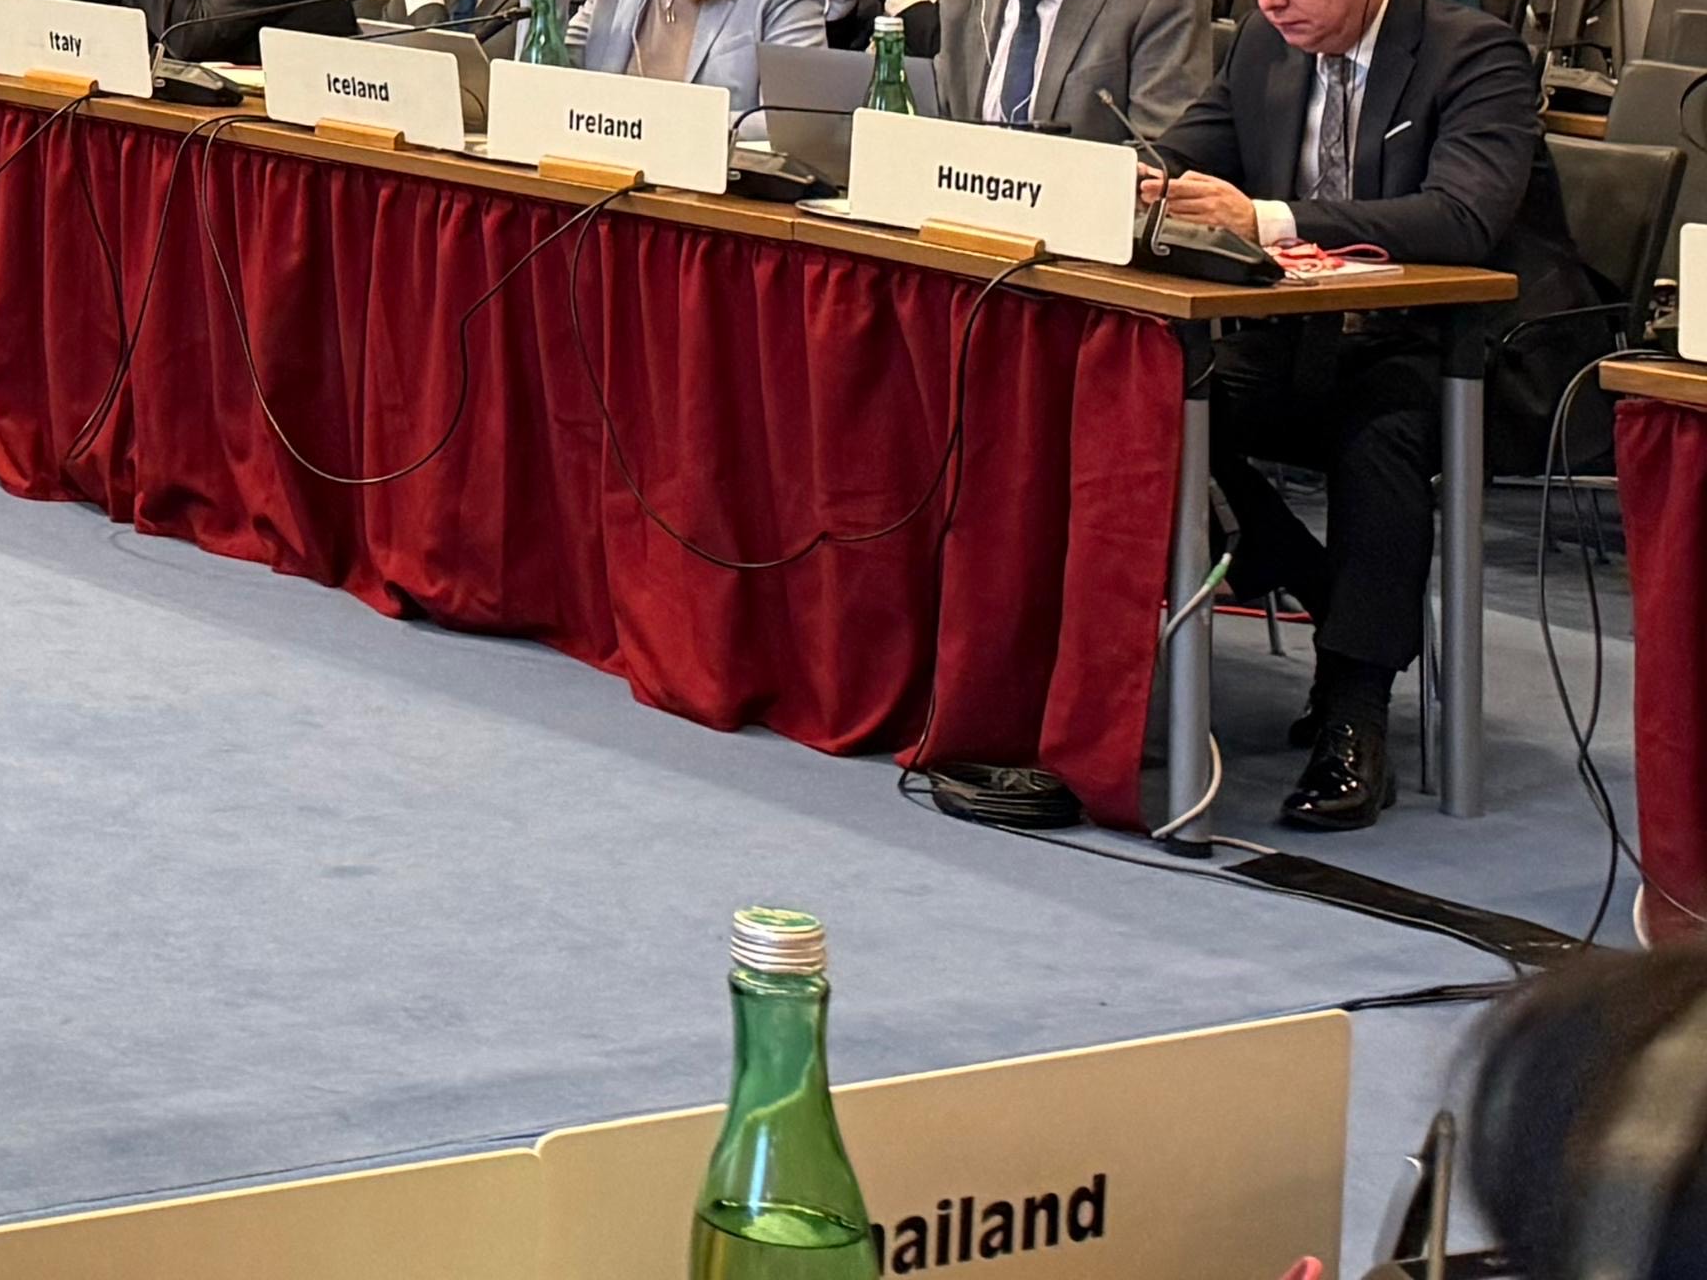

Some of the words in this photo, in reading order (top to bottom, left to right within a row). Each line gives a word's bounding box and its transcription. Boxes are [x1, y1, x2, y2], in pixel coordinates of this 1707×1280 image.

[49, 31, 82, 57] Italy
[326, 73, 390, 102] Iceland
[569, 109, 642, 140] Ireland
[937, 165, 1042, 208] Hungary
